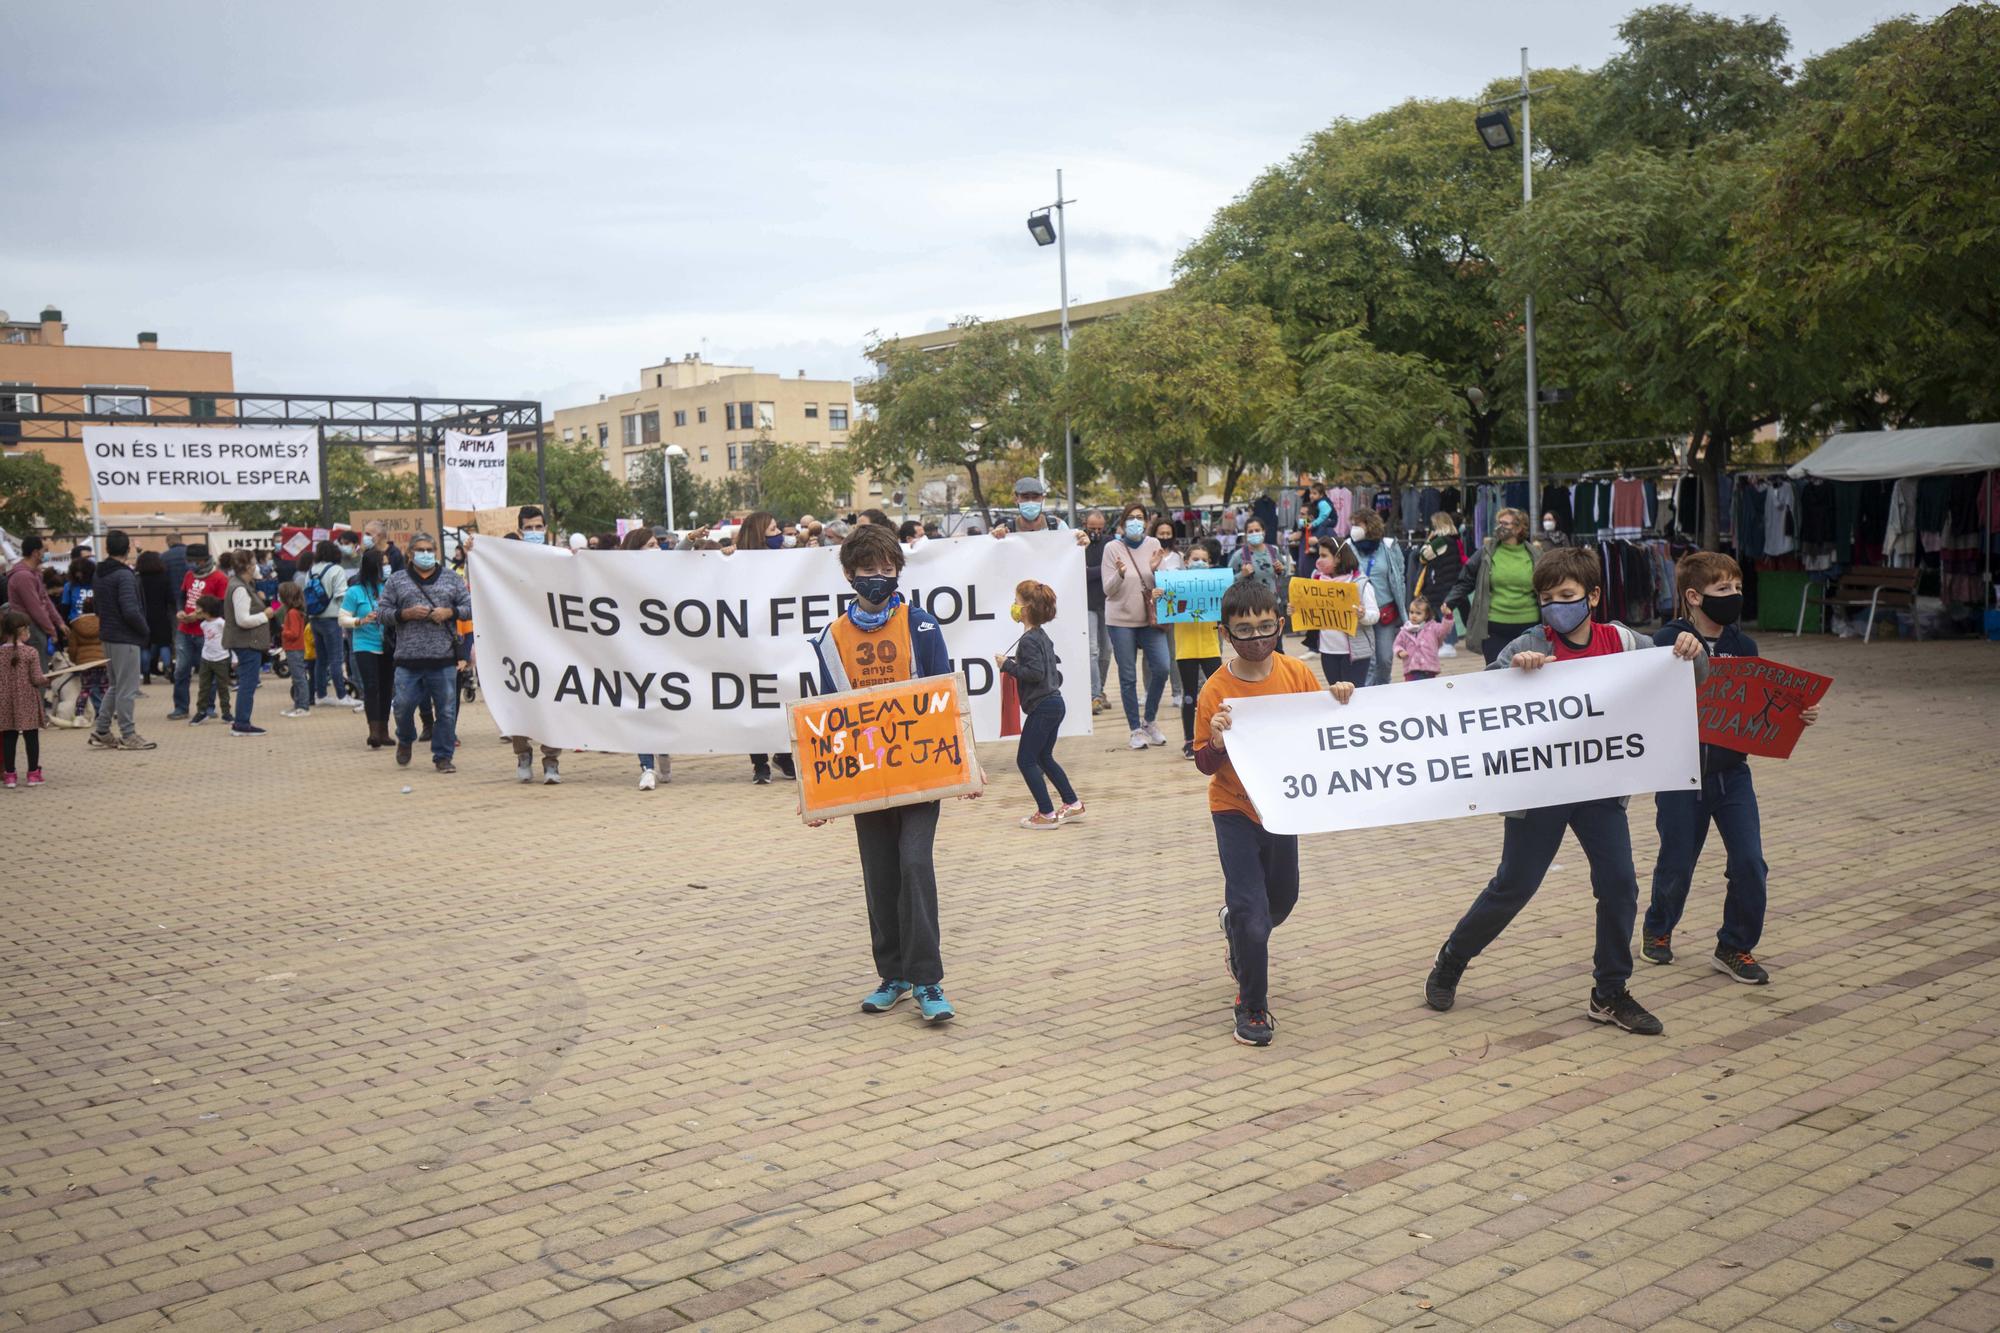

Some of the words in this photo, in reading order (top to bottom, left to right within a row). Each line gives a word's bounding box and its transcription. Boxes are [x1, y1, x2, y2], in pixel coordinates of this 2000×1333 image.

[95, 442, 125, 458] ON
[132, 440, 158, 458] ÉS
[182, 443, 212, 458] IES
[218, 440, 309, 458] PROMÈS?
[458, 440, 495, 453] APIMA
[458, 459, 475, 468] SON
[97, 471, 140, 486] SON
[147, 470, 232, 485] FERRIOL
[237, 470, 311, 485] ESPERA
[1303, 586, 1346, 598] VOLEM
[1315, 599, 1334, 607] UN
[547, 592, 620, 636] IES
[640, 598, 749, 638] SON
[1300, 608, 1352, 630] INSTITUT
[855, 640, 897, 665] 30
[862, 664, 894, 677] anys
[502, 656, 540, 699] 30
[554, 665, 691, 711] ANYS
[712, 672, 780, 710] DE
[1702, 679, 1747, 704] ARA
[805, 698, 906, 737] VOLEM
[913, 691, 950, 716] UN
[1317, 723, 1369, 751] IES
[1379, 713, 1449, 744] SON
[1458, 693, 1605, 734] FERRIOL
[911, 734, 962, 765] JA!
[1282, 773, 1318, 799] 30
[1327, 762, 1417, 796] ANYS
[1427, 754, 1473, 784] DE
[1482, 733, 1645, 776] MENTIDES
